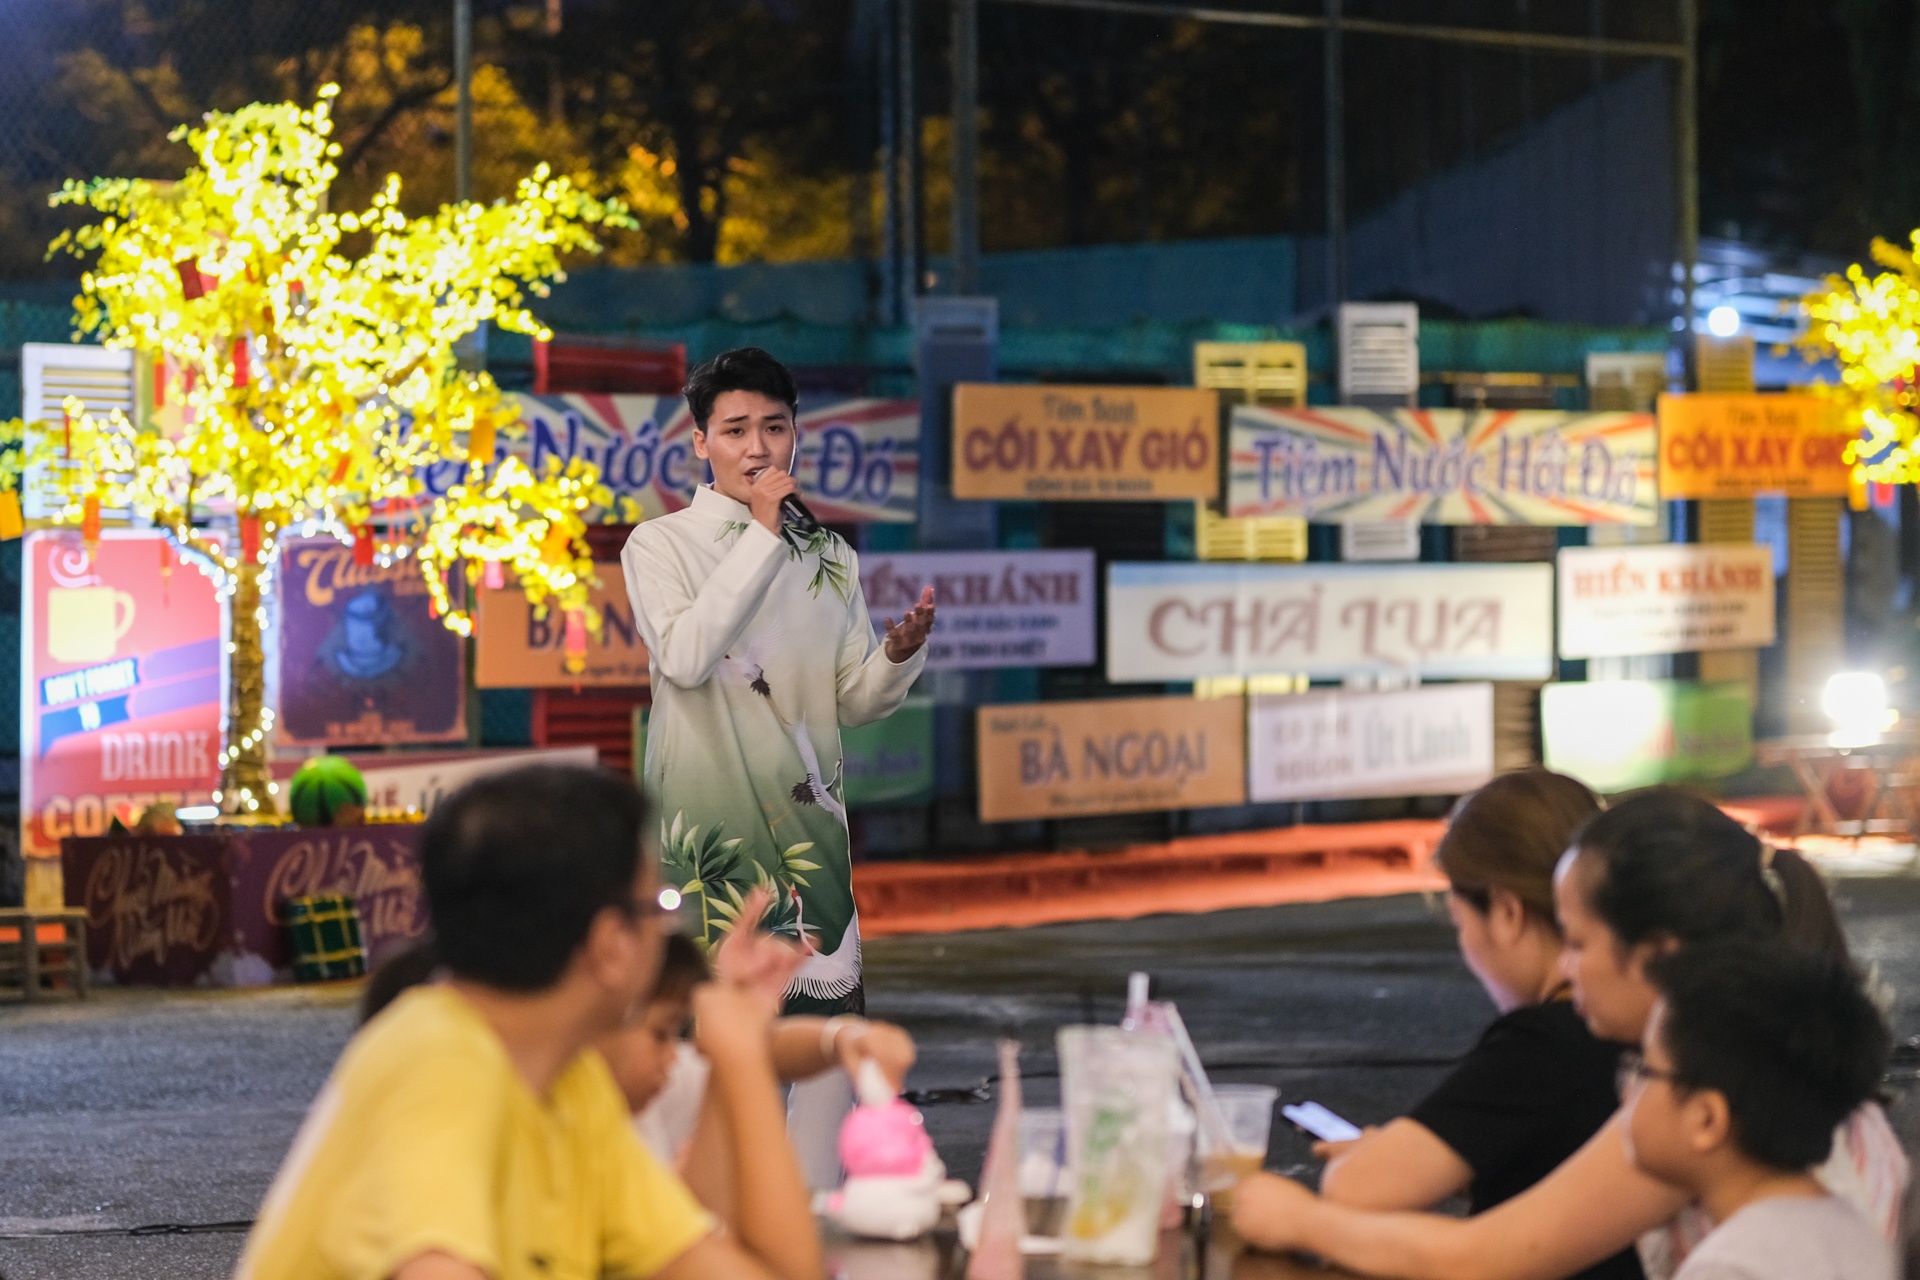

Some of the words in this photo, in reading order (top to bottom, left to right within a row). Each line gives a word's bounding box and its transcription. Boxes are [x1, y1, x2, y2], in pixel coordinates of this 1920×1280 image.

[815, 422, 895, 500] Đó
[1050, 429, 1129, 471] XAY
[1139, 414, 1209, 472] GIÓ
[1733, 437, 1791, 469] XAY
[1253, 432, 1356, 515] Tiệm
[1371, 430, 1487, 494] Nước
[934, 562, 1081, 606] KHÁNH
[100, 731, 211, 782] DRINK
[1020, 723, 1070, 784] BÀ
[1083, 730, 1206, 787] NGOẠI
